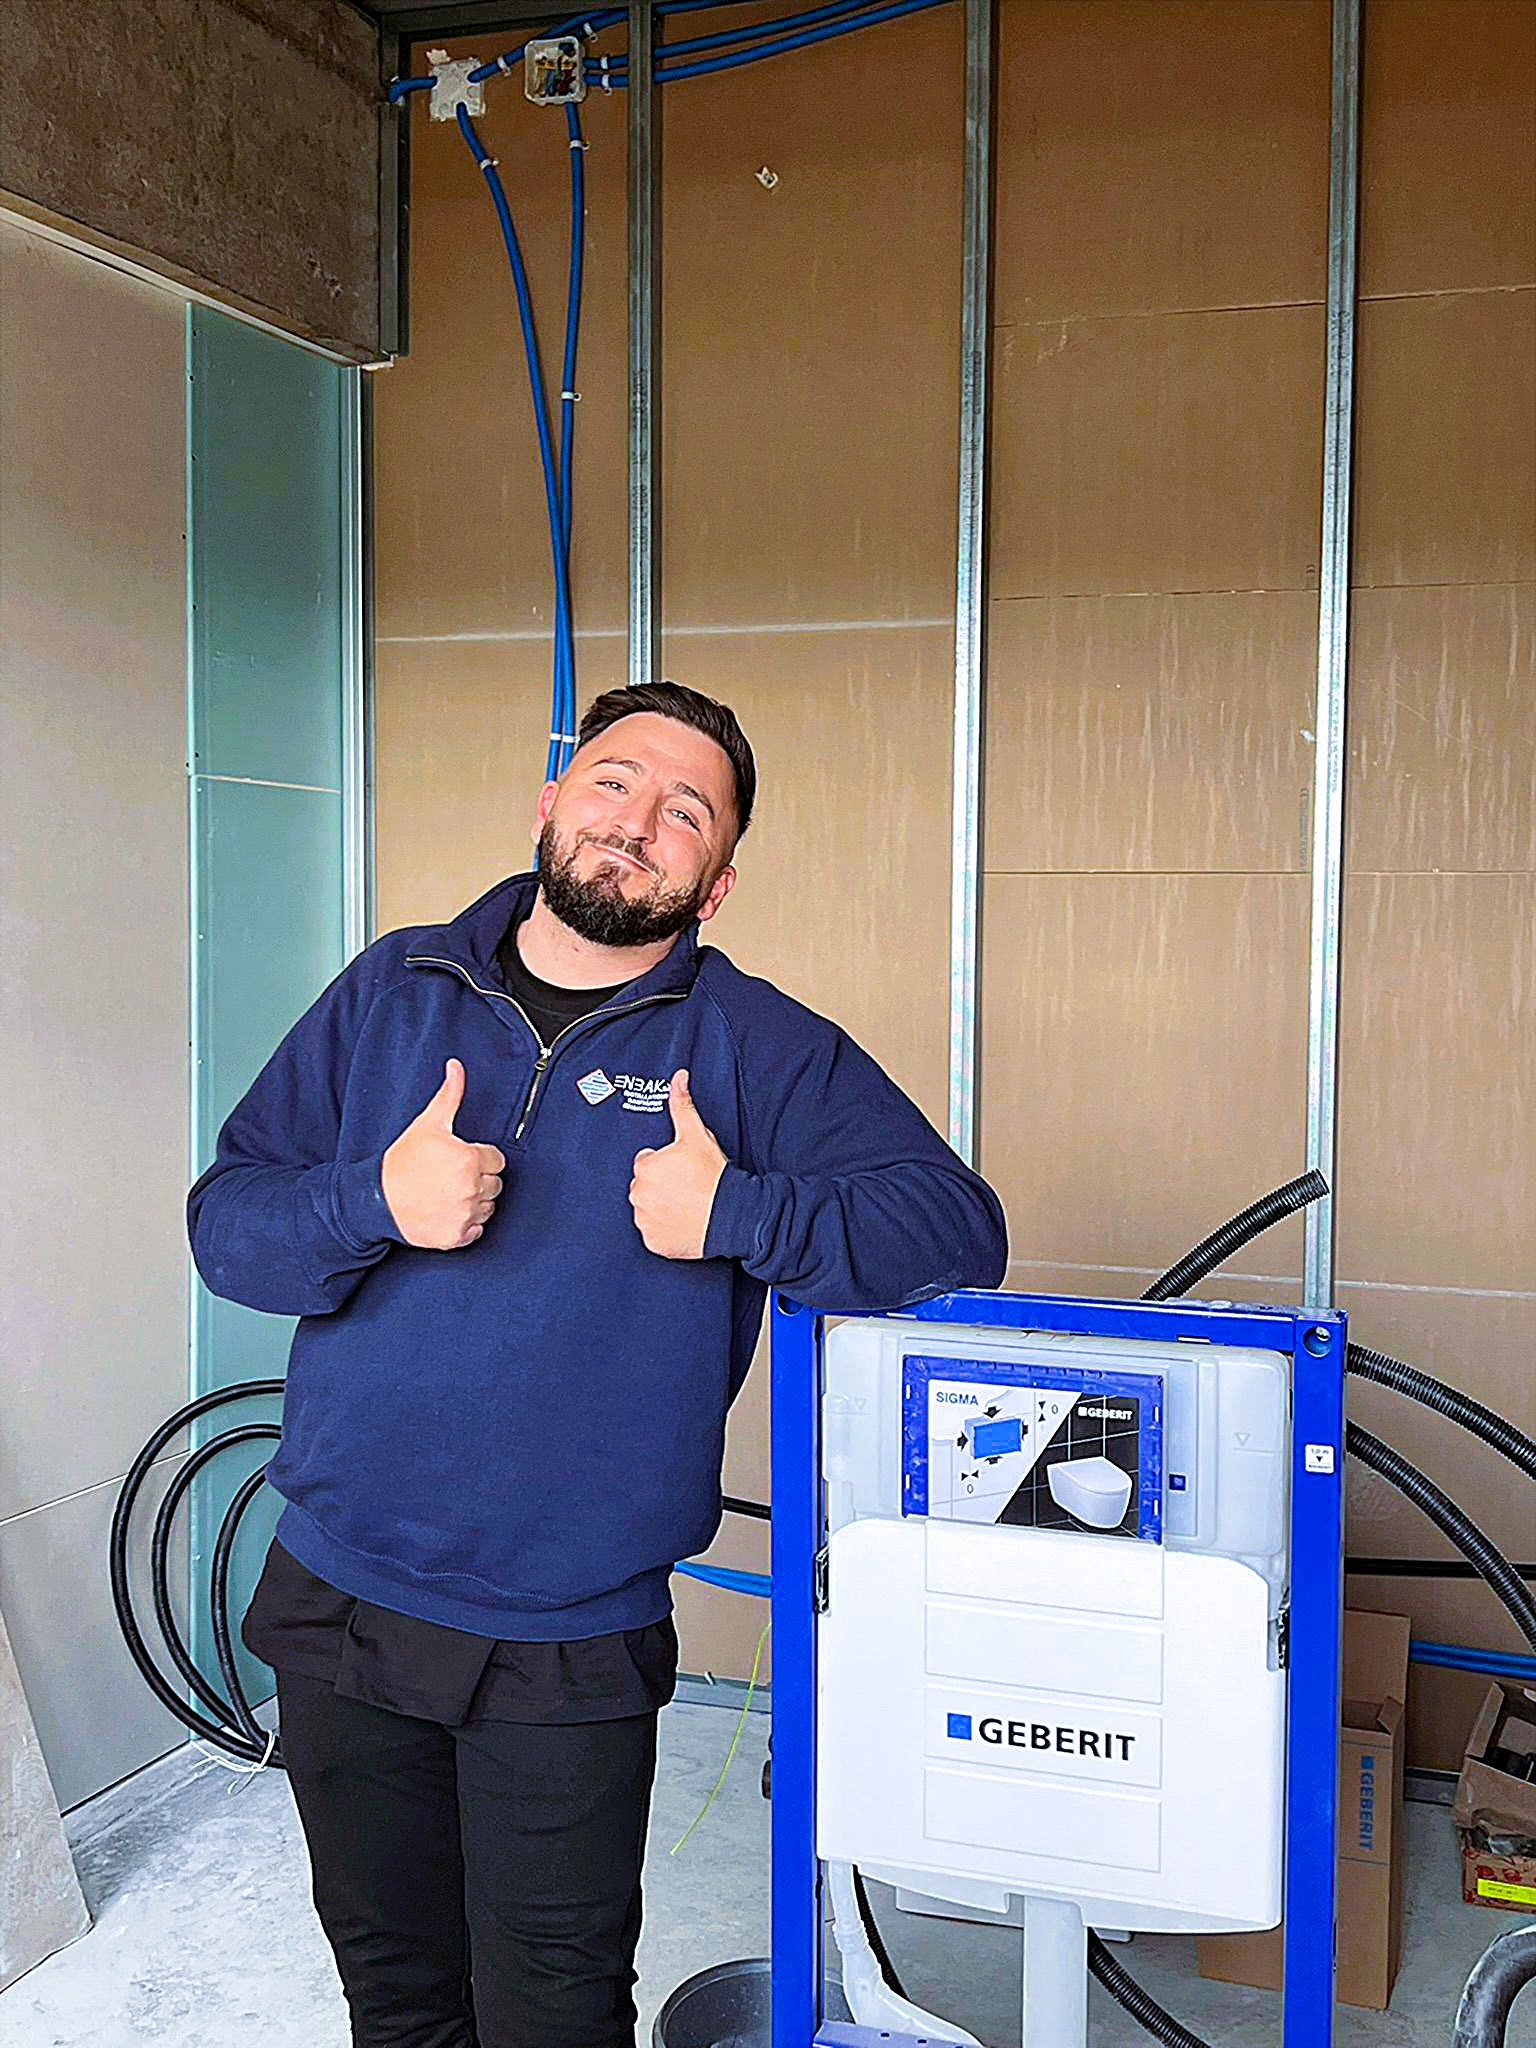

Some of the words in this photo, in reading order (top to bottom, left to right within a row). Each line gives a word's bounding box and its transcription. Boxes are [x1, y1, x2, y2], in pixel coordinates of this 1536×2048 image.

[936, 1391, 979, 1406] SIGMA
[1051, 1404, 1059, 1415] 0
[1087, 1407, 1133, 1421] GEBERIT
[966, 1483, 974, 1494] 0
[978, 1717, 1136, 1761] GEBERIT
[1360, 1772, 1376, 1850] GEBERIT
